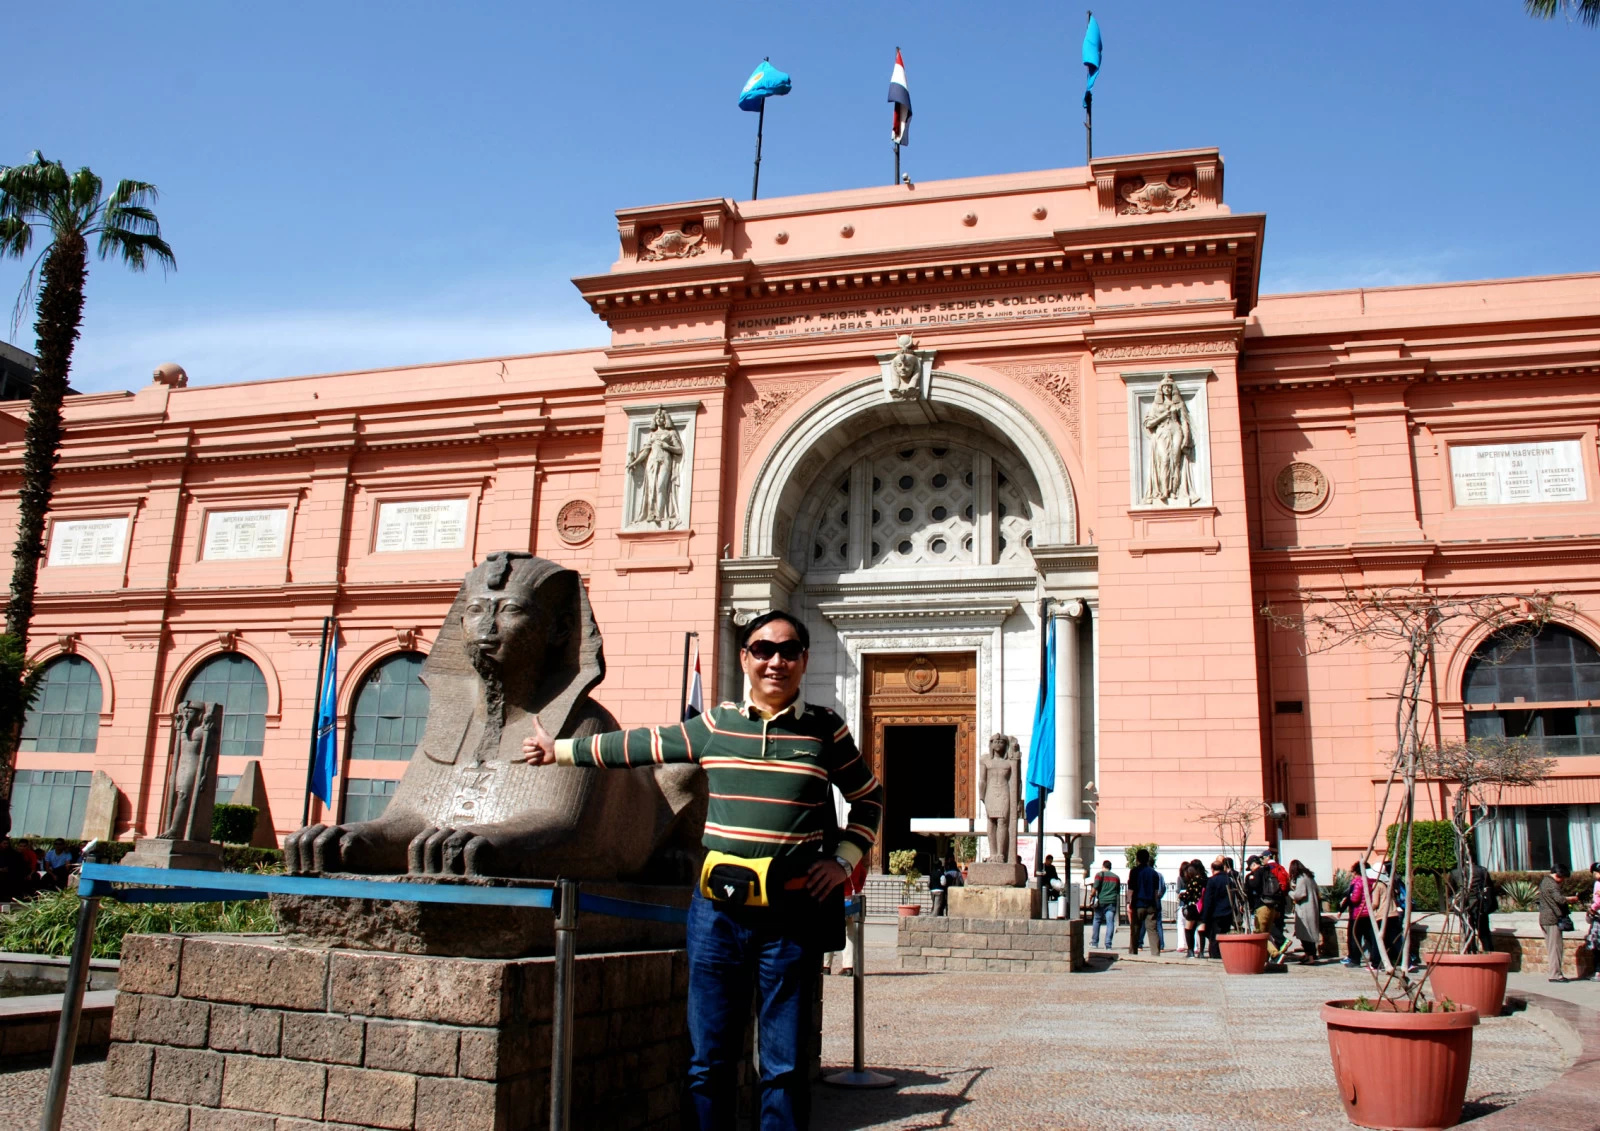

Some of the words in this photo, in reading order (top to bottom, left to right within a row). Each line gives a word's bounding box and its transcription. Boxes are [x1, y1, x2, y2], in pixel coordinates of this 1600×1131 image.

[737, 314, 812, 328] MONVMENTA
[819, 308, 868, 320] PRIORIS
[875, 306, 904, 316] AEVI
[911, 303, 931, 313] HIS
[938, 298, 995, 311] SEDIBVS
[1002, 292, 1085, 306] COLLOCAVIT
[880, 317, 913, 327] HILMI
[920, 311, 985, 323] PRINCEPS
[1477, 450, 1510, 459] IMPERIVM
[1512, 448, 1555, 457] HABVERVNT
